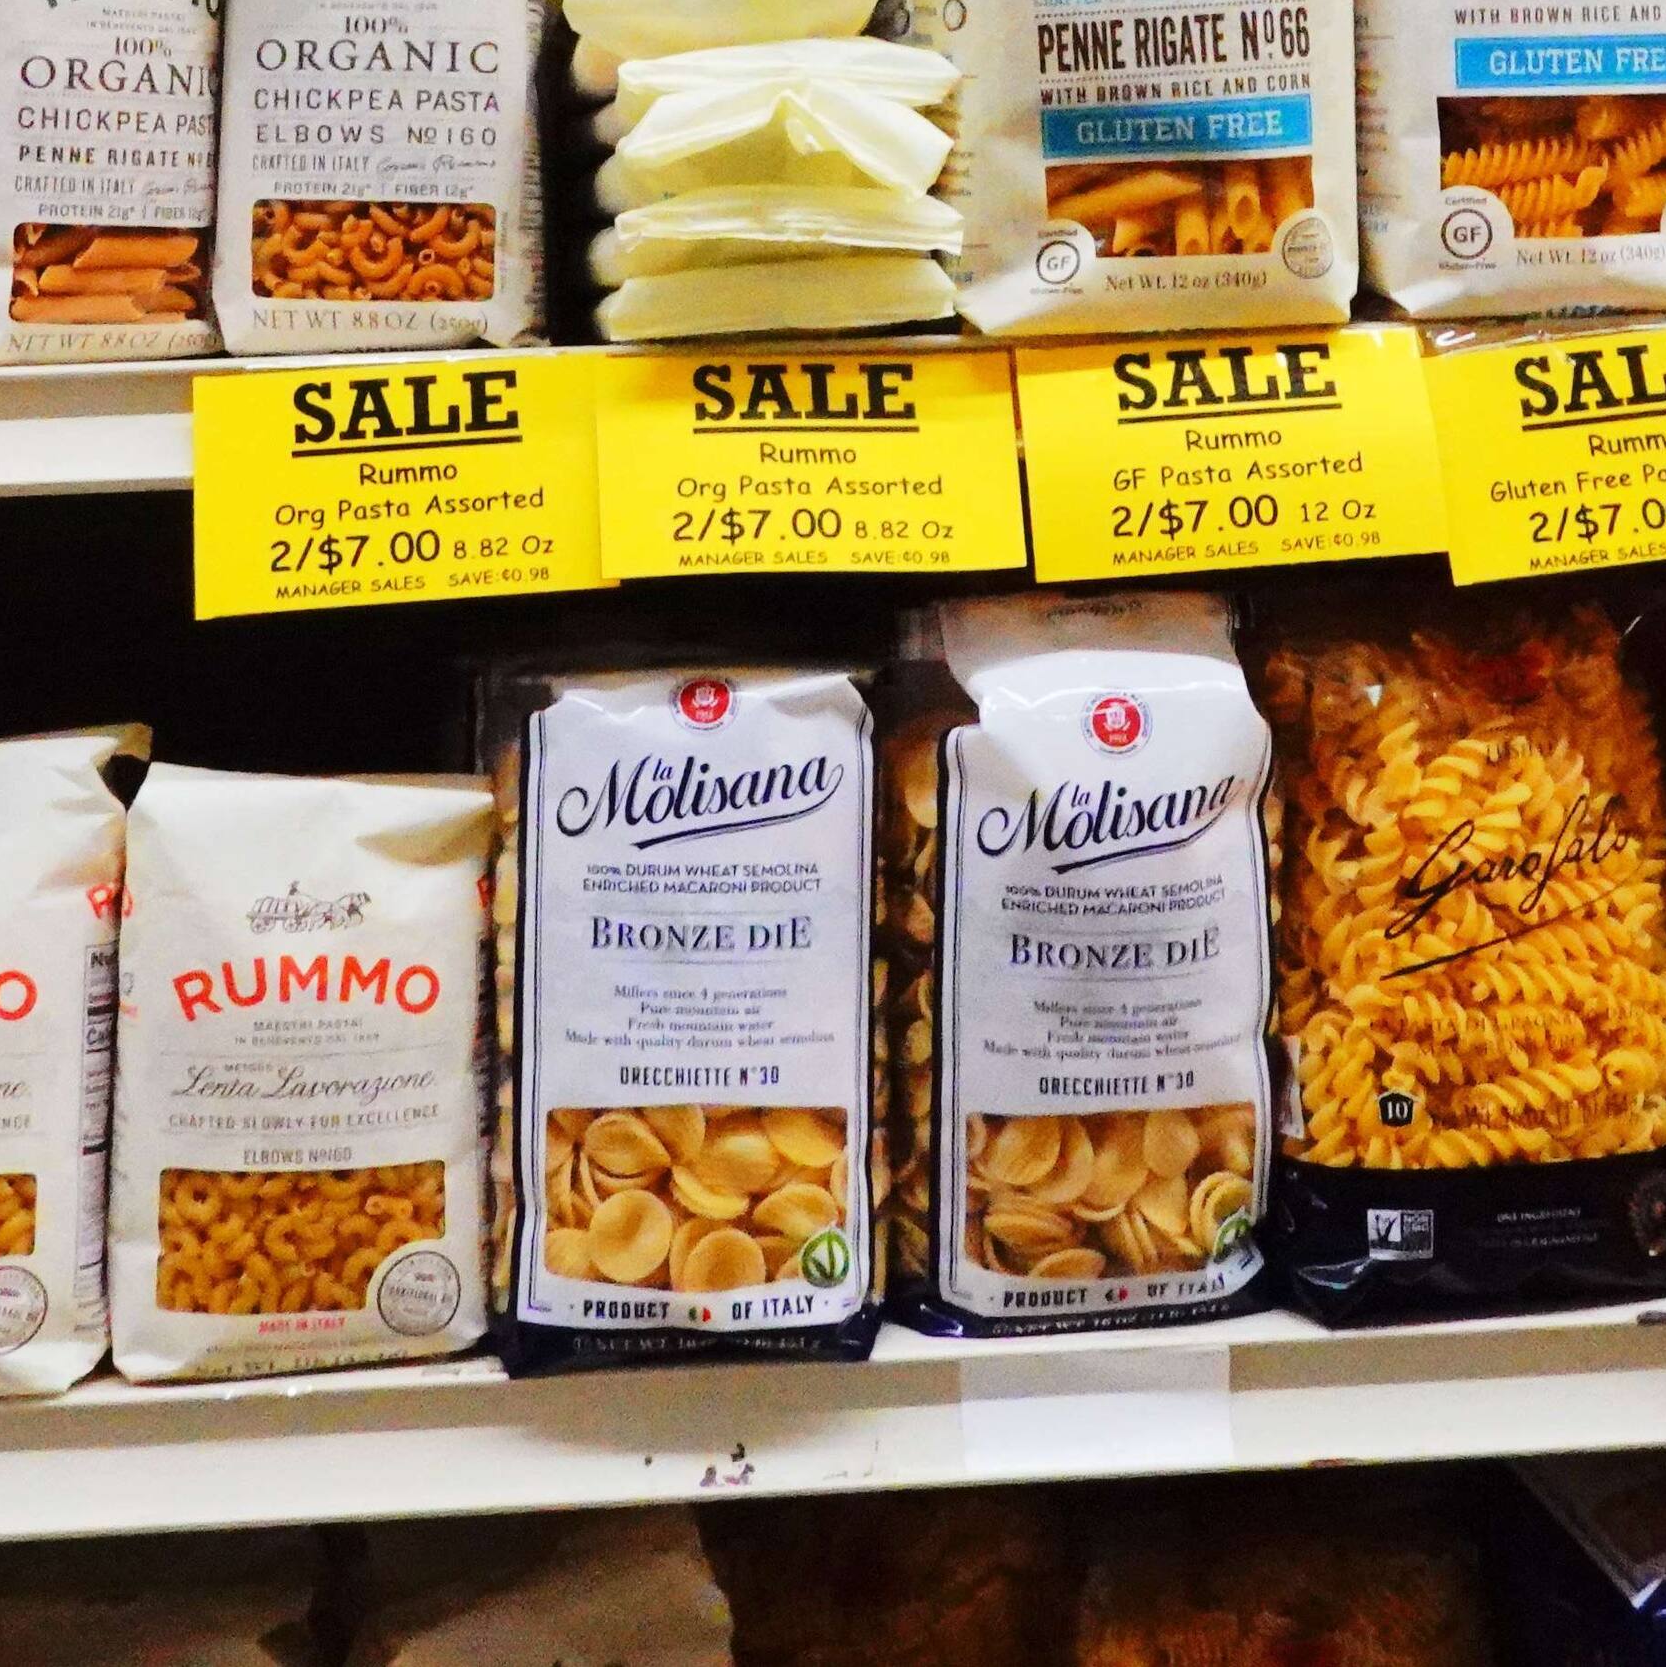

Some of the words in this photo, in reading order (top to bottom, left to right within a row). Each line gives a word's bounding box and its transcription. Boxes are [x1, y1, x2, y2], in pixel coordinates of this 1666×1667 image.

[256, 39, 499, 75] ORGANIC
[1038, 19, 1125, 76] PENNE
[1134, 12, 1228, 70] RIGATE
[1489, 48, 1605, 77] GLUTEN
[253, 87, 405, 112] CHICKPEA
[416, 91, 500, 112] PASTA
[1040, 86, 1086, 106] WITH
[1096, 83, 1163, 103] BROWN
[1171, 79, 1213, 99] RICE
[1222, 76, 1258, 94] AND
[1267, 74, 1311, 92] CORN
[256, 124, 385, 146] ELBOWS
[1077, 114, 1195, 145] GLUTEN
[1208, 110, 1284, 139] FREE
[19, 145, 96, 164] PENNE
[107, 147, 180, 168] RIGATE
[1047, 253, 1071, 271] GF
[692, 362, 916, 422] SALE
[1112, 342, 1338, 412] SALE
[292, 369, 518, 445] SALE
[759, 442, 857, 464] Rummo
[1185, 429, 1282, 452] Rummo
[359, 462, 458, 486] Rummo
[1113, 468, 1147, 491] GF
[1161, 463, 1232, 487] Pasta
[1246, 451, 1363, 481] Assorted
[1490, 478, 1566, 503] Gluten
[1576, 471, 1631, 492] Free
[275, 504, 325, 531] Org
[338, 499, 411, 522] Pasta
[425, 487, 544, 515] Assorted
[522, 534, 554, 555] Oz
[554, 752, 845, 837] Molisana
[977, 774, 1238, 858] Molisana
[625, 863, 682, 878] DURUM
[684, 862, 738, 878] WHEAT
[1385, 793, 1637, 938] Garofalo
[591, 916, 735, 951] BRONZE
[748, 915, 813, 949] DIE
[172, 953, 442, 1023] RUMMO
[619, 1065, 732, 1087] ORECCHIETTE
[582, 1299, 669, 1322] PRODUCT
[732, 1300, 758, 1321] OF
[762, 1294, 815, 1319] ITALY
